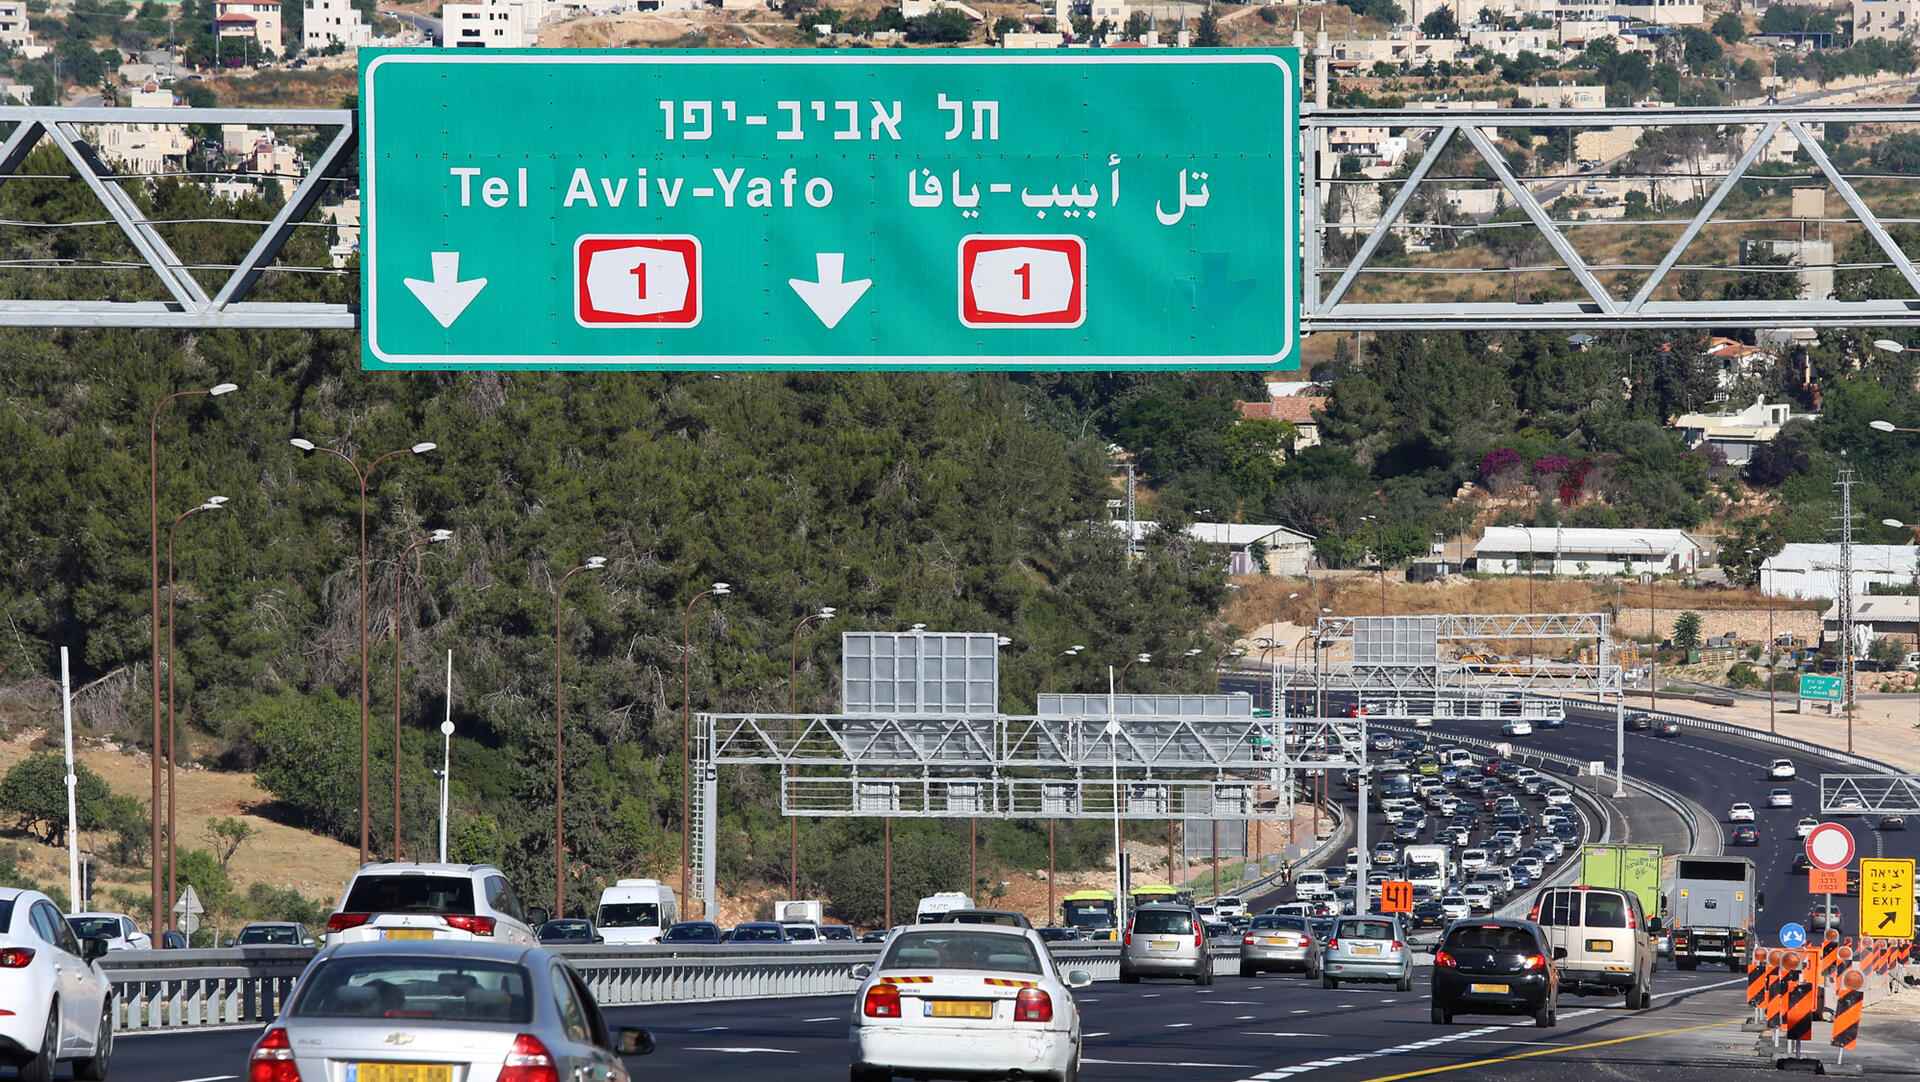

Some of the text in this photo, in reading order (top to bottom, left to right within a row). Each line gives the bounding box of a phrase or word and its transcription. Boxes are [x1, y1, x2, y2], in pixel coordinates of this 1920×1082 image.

[660, 94, 998, 140] תל אביב-יפו
[449, 167, 834, 208] Tel Aviv-Yafo
[908, 153, 1210, 226] تل أبيب-يافا
[629, 262, 647, 300] 1
[1014, 263, 1031, 300] 1
[1870, 868, 1905, 878] יציאה
[1871, 880, 1903, 893] خروج
[1872, 896, 1902, 906] EXIT
